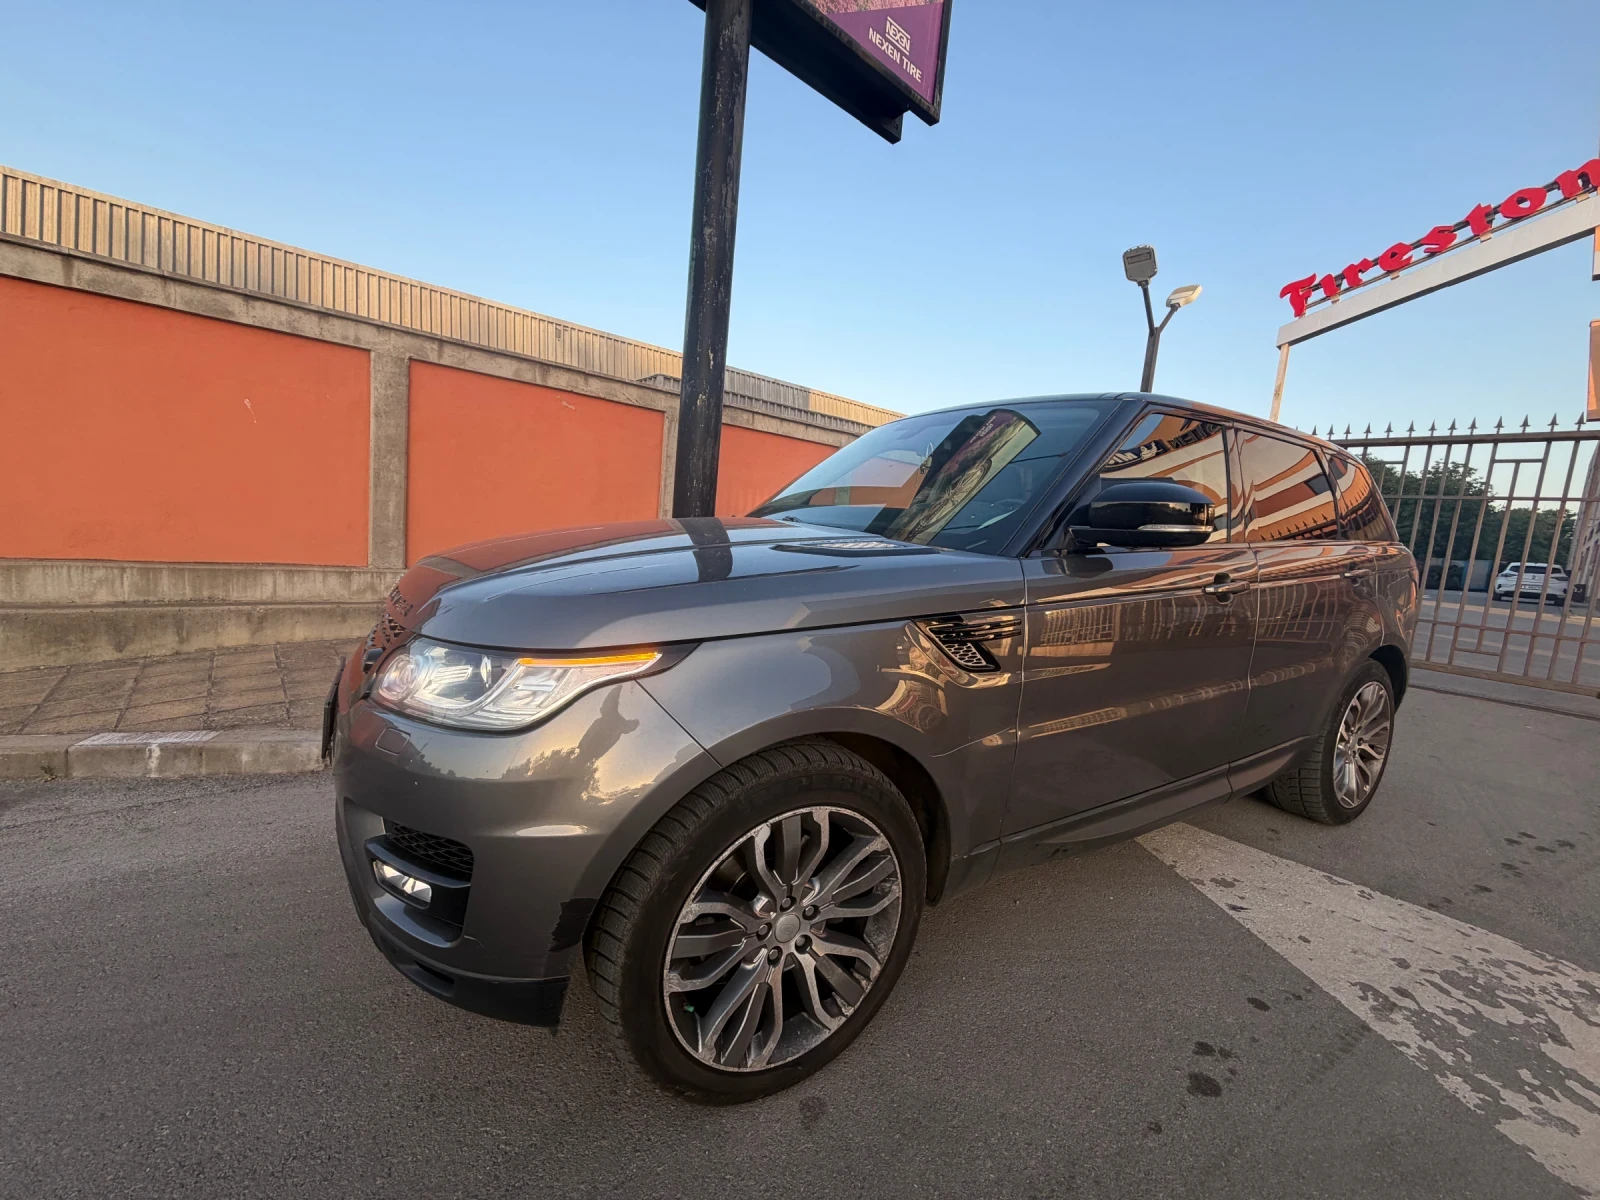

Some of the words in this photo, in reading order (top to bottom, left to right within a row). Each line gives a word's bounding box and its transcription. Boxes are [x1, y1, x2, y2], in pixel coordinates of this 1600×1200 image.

[868, 27, 901, 65] NEXEN
[902, 55, 922, 83] TIRE
[886, 20, 910, 52] NEXEN
